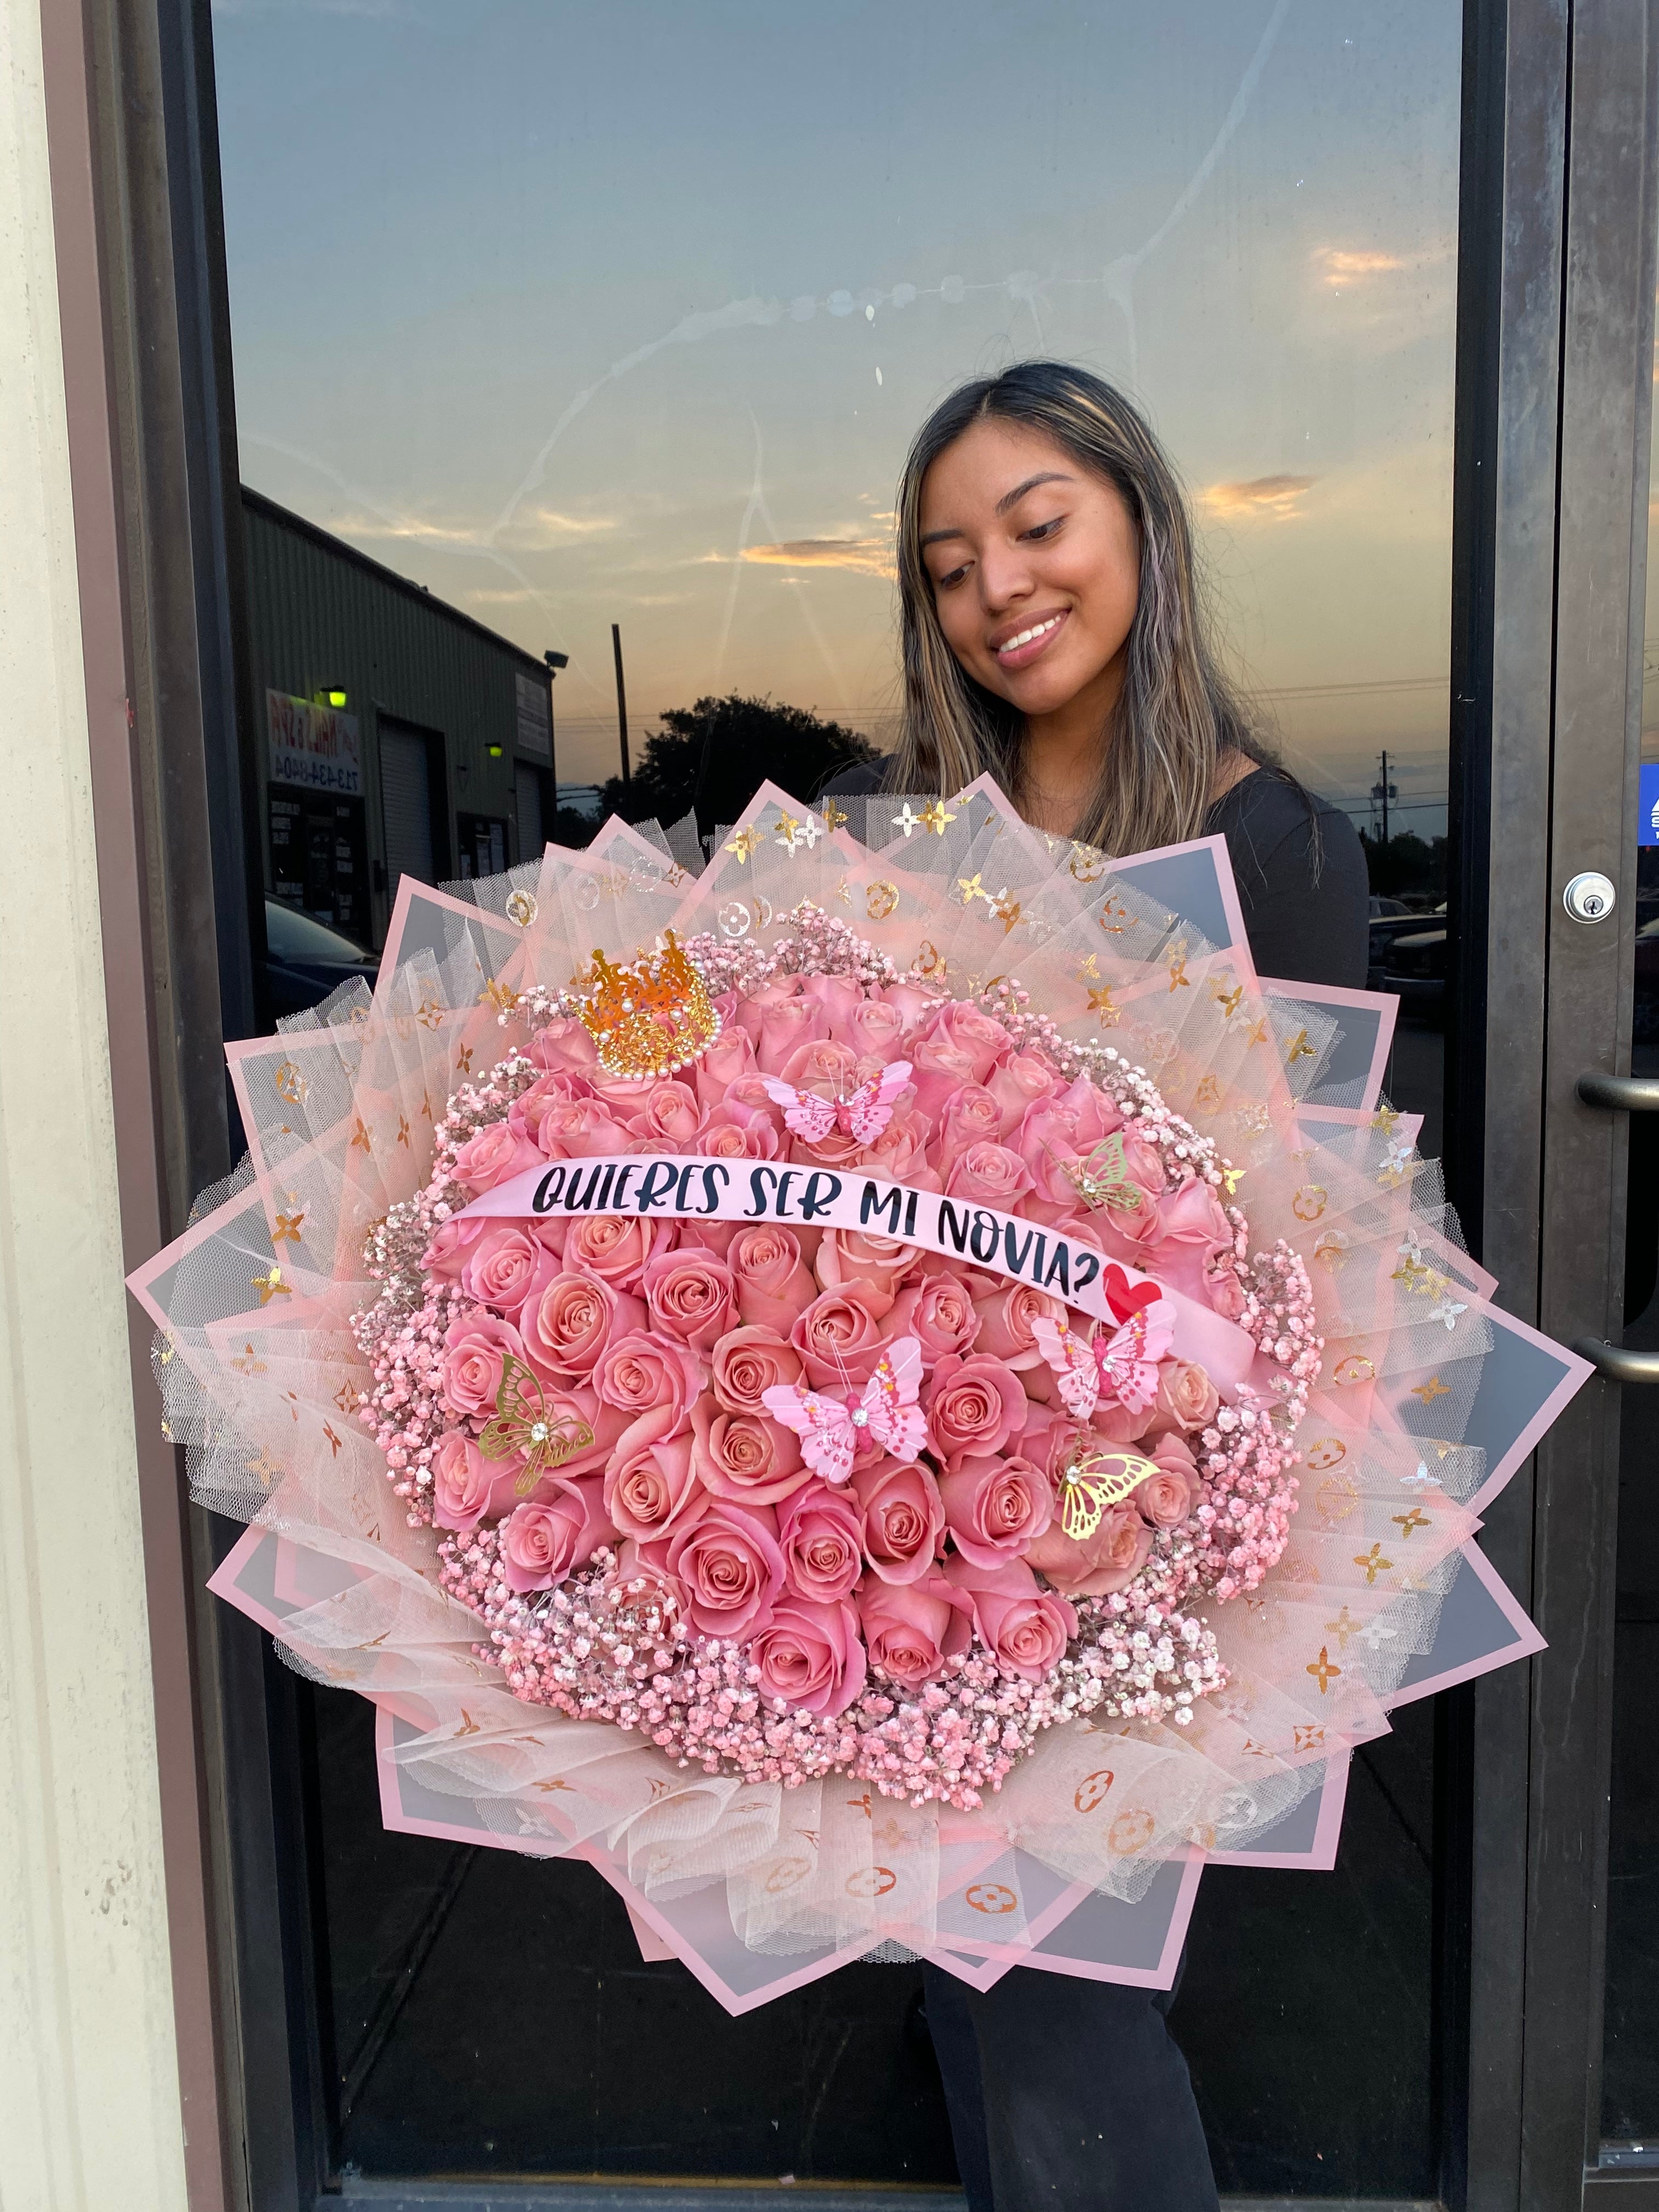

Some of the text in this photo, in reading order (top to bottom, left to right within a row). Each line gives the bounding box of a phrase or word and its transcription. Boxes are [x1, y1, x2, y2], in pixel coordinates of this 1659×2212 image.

[532, 1161, 1100, 1304] QUIERES SER MI NOVIA?
